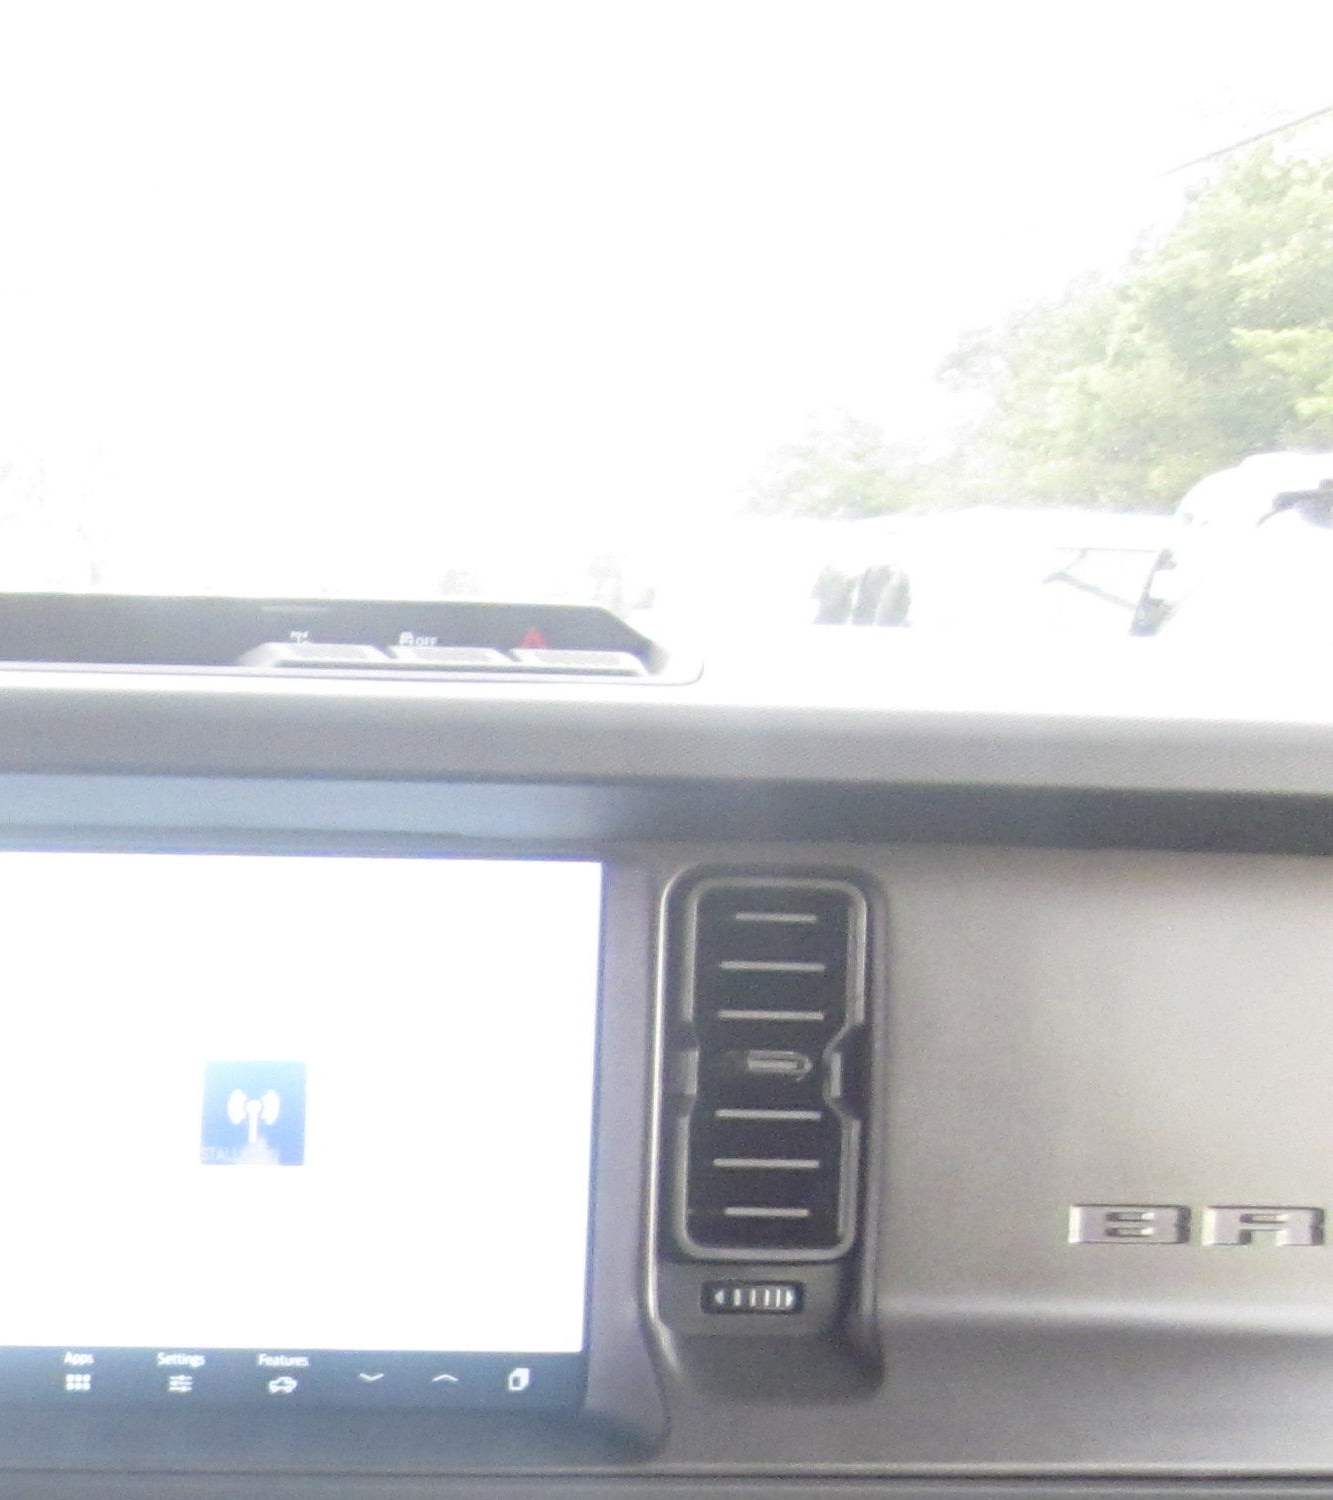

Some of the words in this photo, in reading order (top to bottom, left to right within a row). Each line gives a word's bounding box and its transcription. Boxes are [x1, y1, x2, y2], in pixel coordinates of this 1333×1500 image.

[63, 1351, 95, 1367] Apps
[156, 1351, 206, 1368] Settings
[257, 1353, 309, 1368] Features
